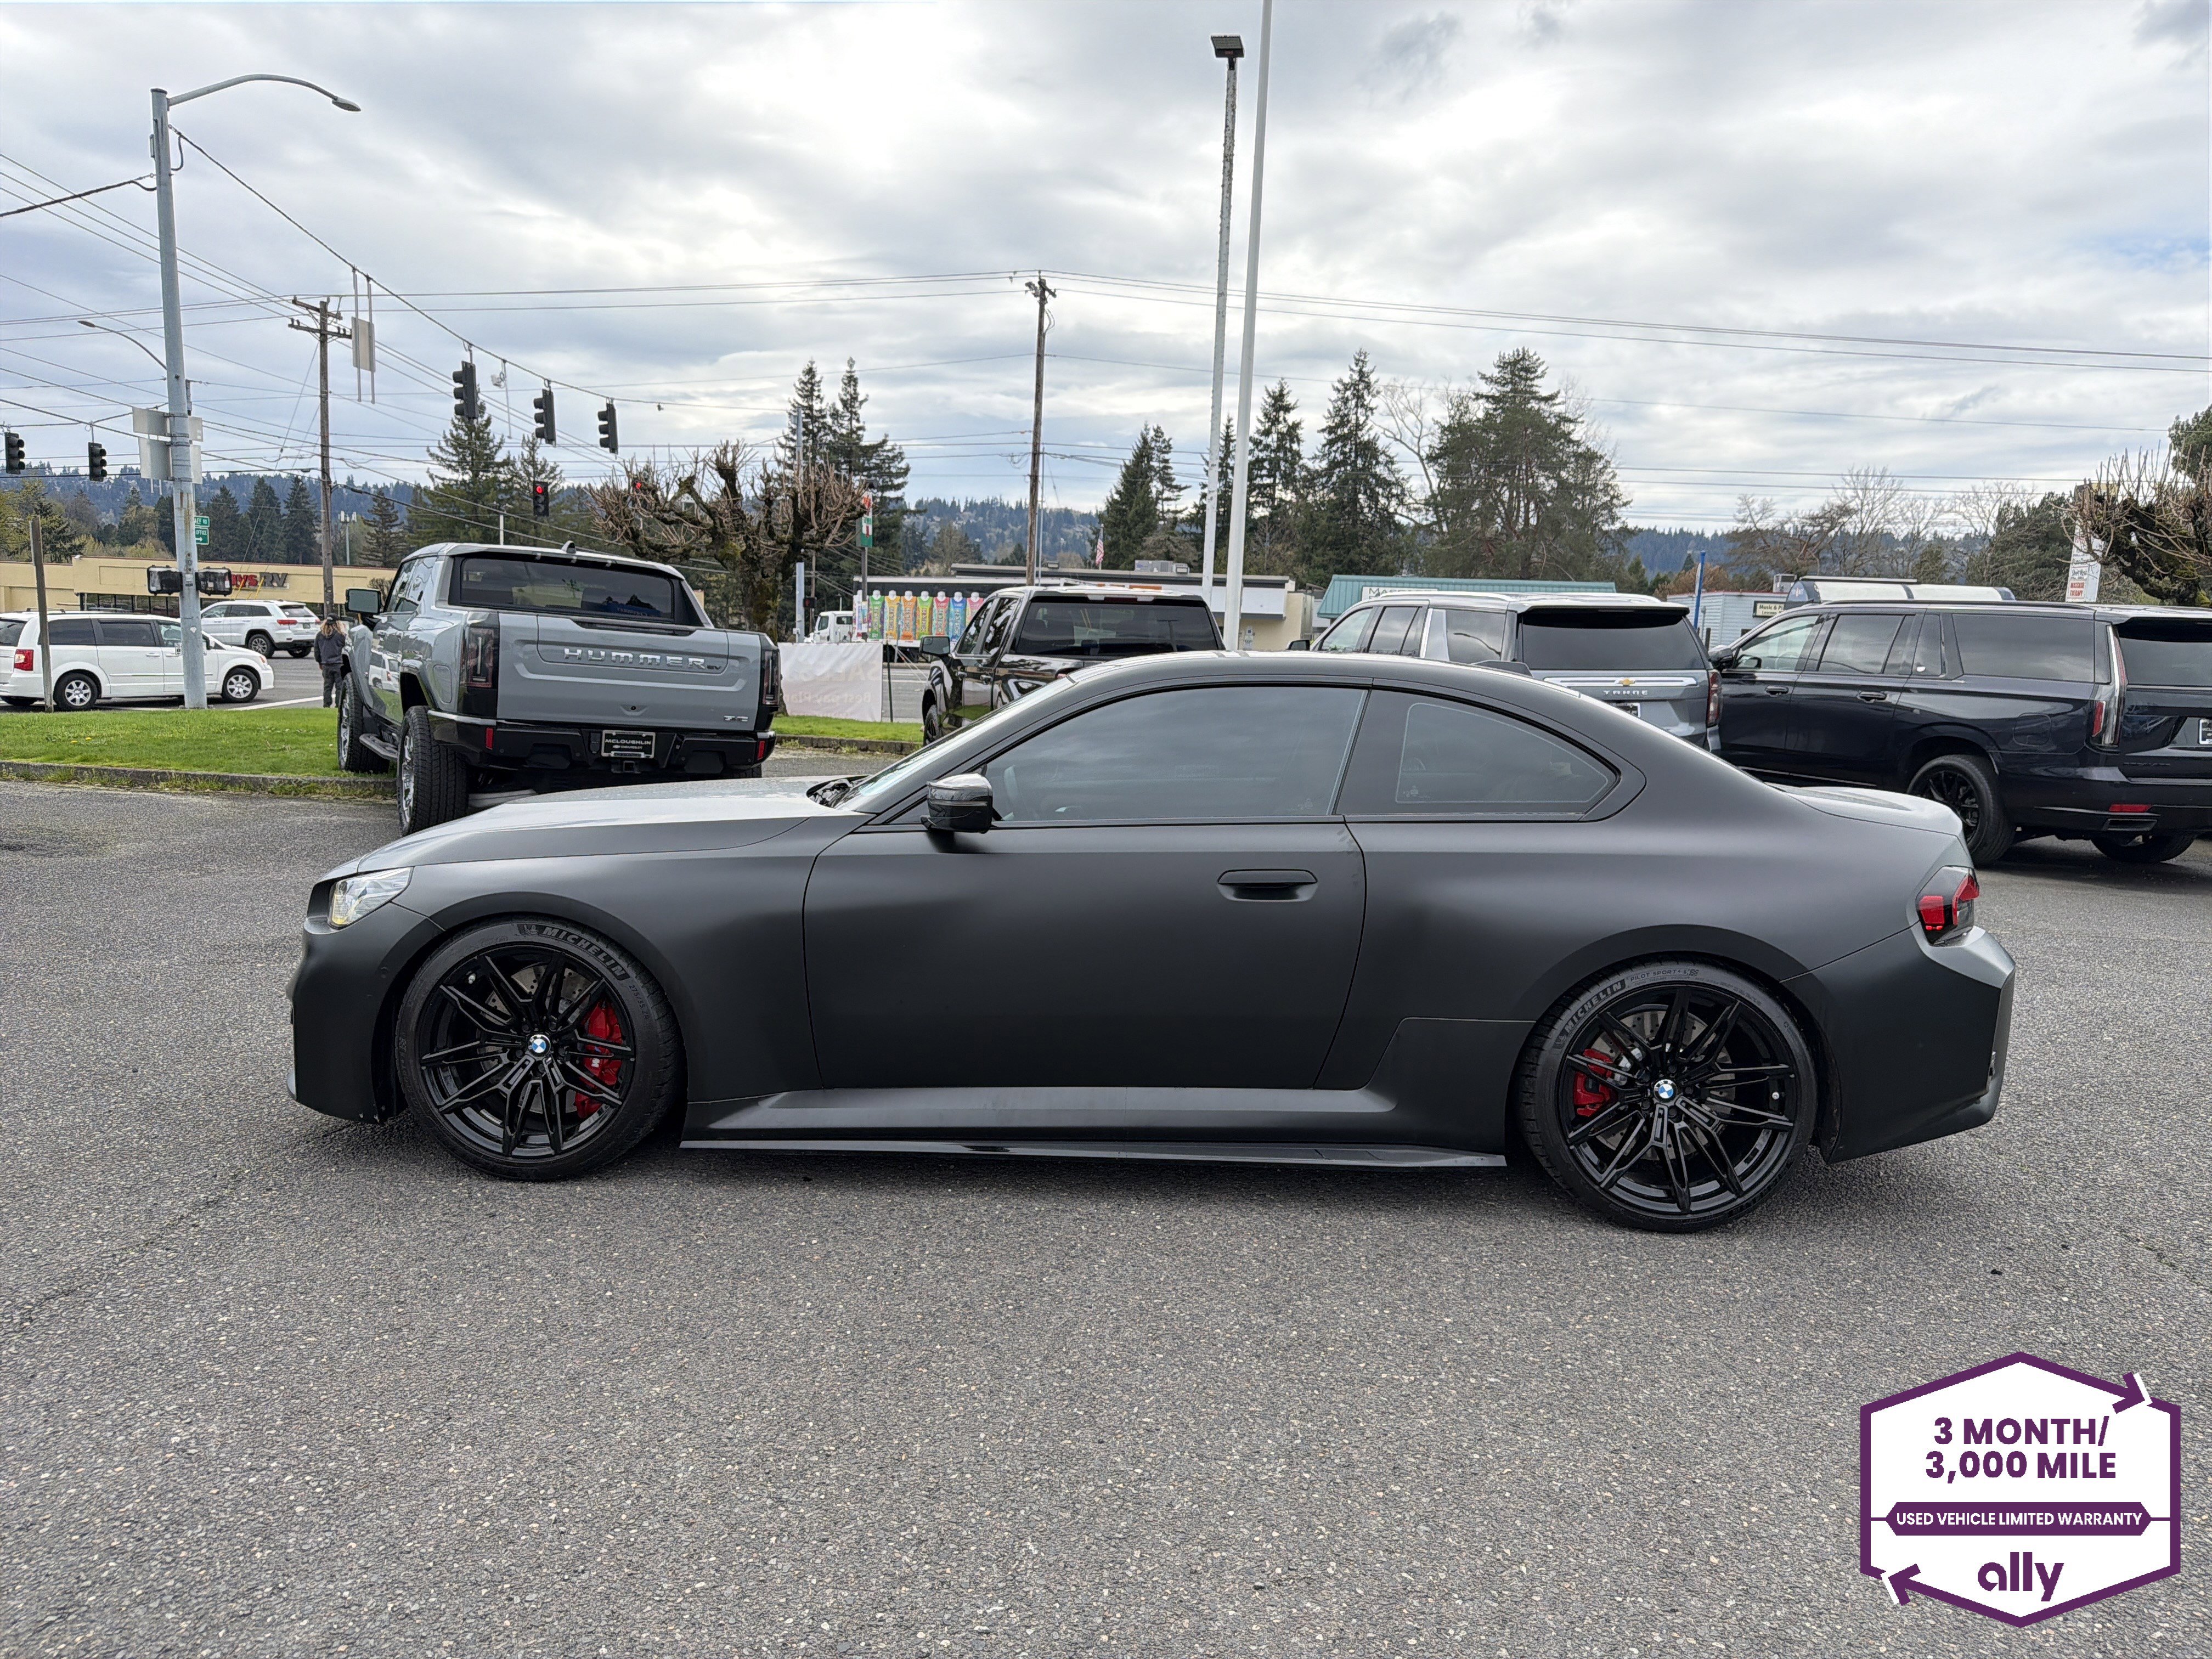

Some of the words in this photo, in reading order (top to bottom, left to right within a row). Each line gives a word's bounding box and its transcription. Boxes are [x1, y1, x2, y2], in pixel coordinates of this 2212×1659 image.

[259, 572, 288, 587] RV
[564, 648, 706, 670] HUMMER
[542, 926, 627, 977] MICHELIN
[1630, 973, 1650, 982] PILOT
[1564, 980, 1623, 1034] MICHELIN
